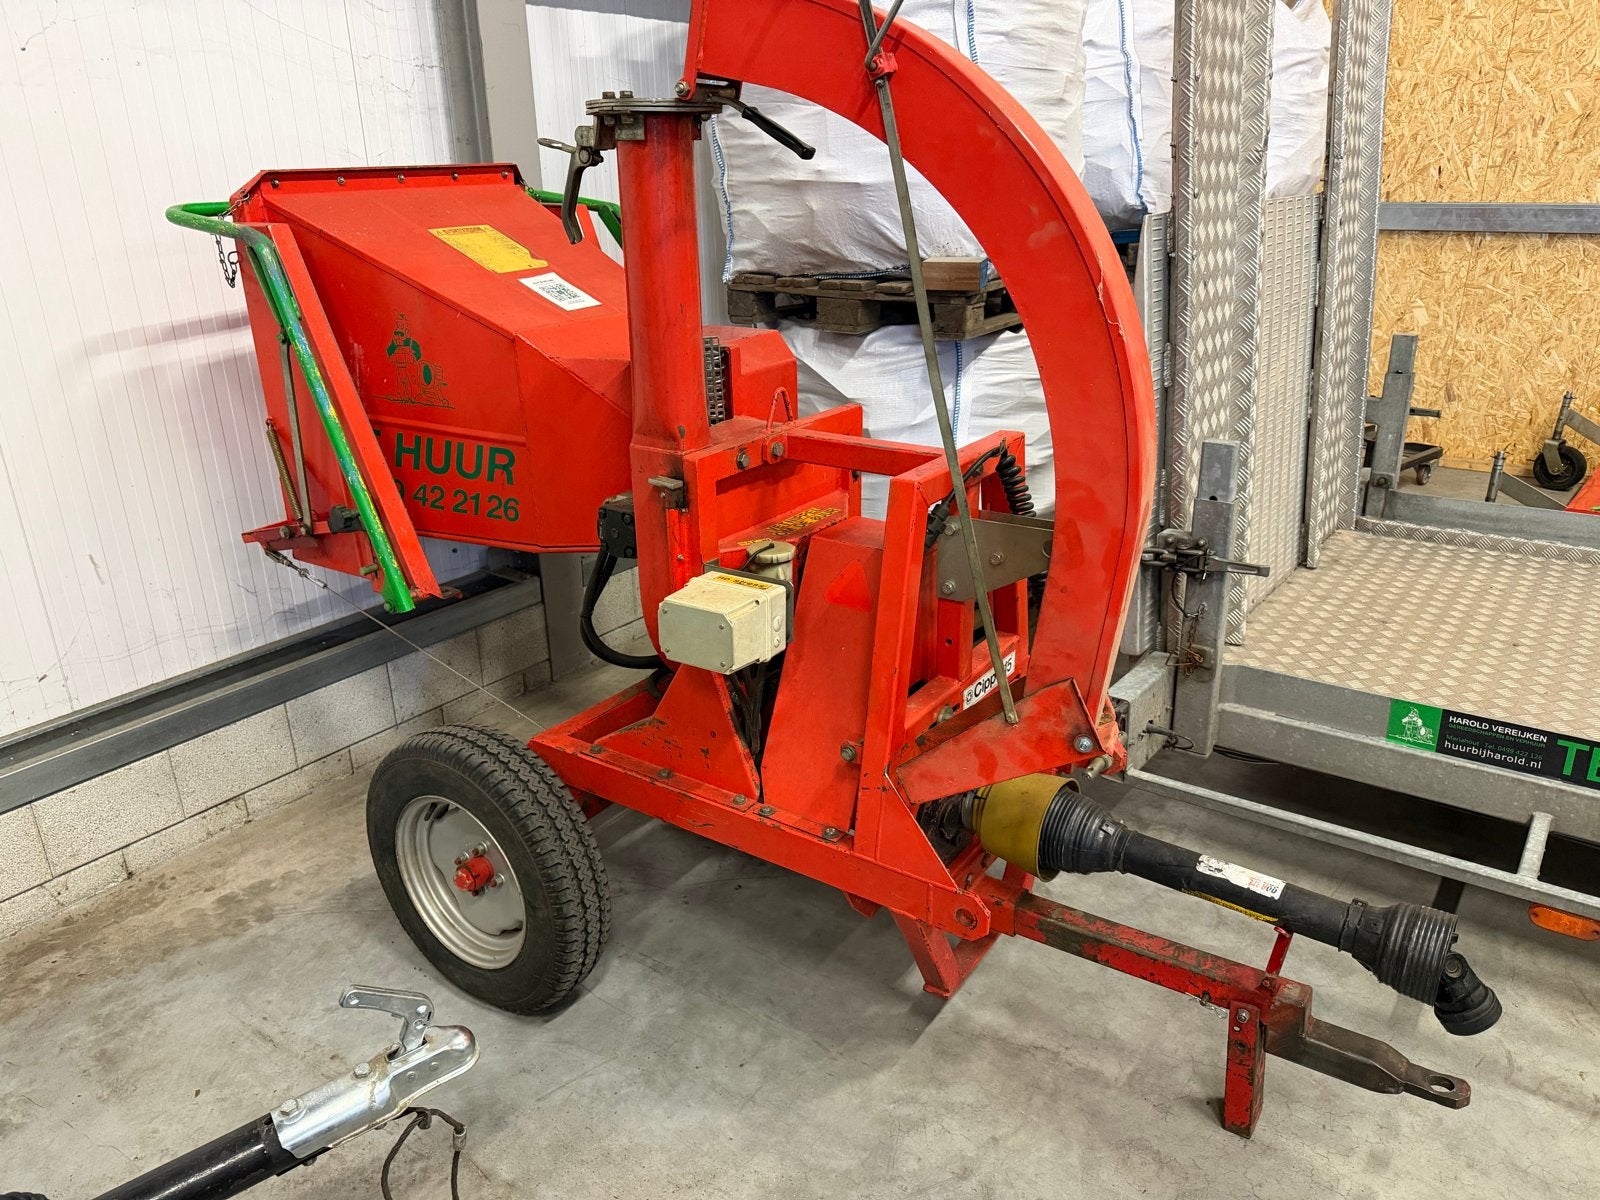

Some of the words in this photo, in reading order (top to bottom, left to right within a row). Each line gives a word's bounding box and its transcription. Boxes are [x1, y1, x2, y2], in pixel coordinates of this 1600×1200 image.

[395, 432, 516, 485] HUUR
[413, 483, 445, 510] 42
[974, 673, 997, 698] Cipp
[1449, 715, 1490, 730] HAROLD
[1492, 724, 1548, 743] VEREIJKEN
[1444, 740, 1542, 769] huurbijharold.nl
